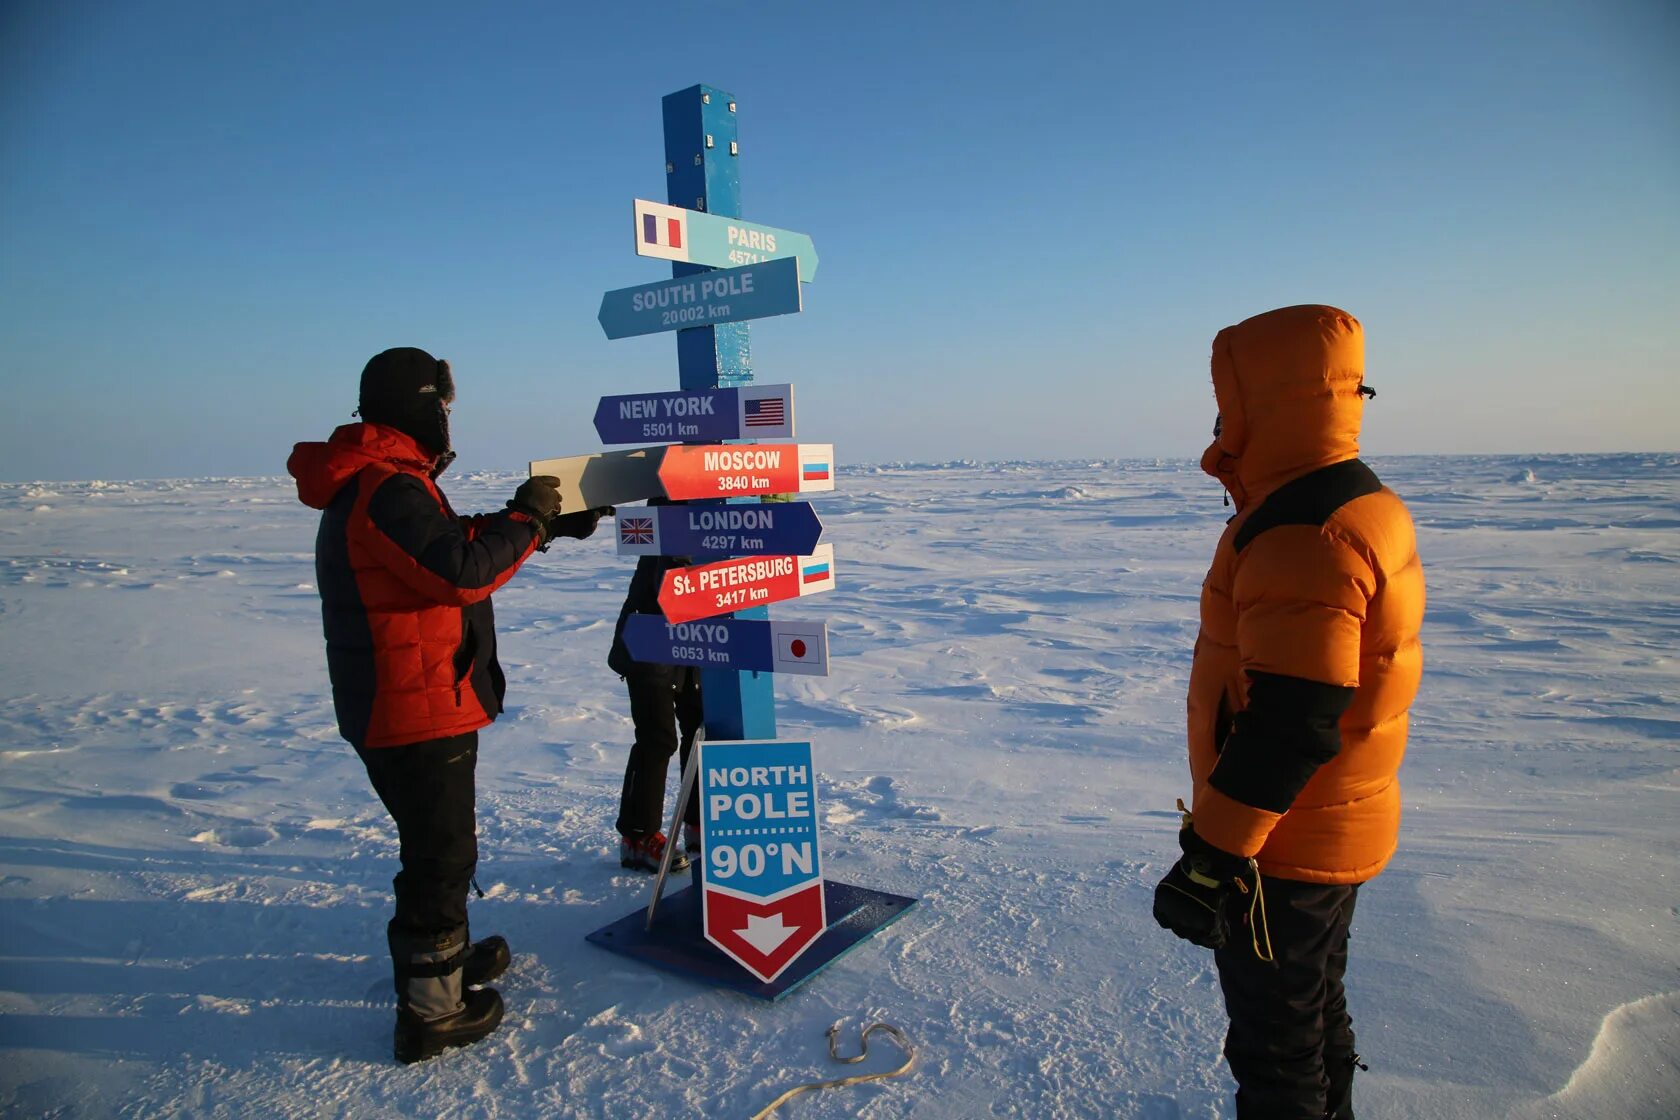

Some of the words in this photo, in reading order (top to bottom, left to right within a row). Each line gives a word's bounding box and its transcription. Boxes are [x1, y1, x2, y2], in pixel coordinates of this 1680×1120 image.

[727, 226, 776, 253] PARIS
[728, 249, 757, 265] 4571
[632, 283, 696, 312] SOUTH
[702, 273, 755, 300] POLE
[708, 304, 730, 319] km
[619, 399, 657, 419] NEW
[662, 396, 715, 417] YORK
[643, 422, 674, 437] 5501
[678, 421, 699, 436] km
[704, 451, 780, 471] MOSCOW
[718, 476, 749, 491] 3840
[751, 475, 770, 489] km
[689, 510, 773, 530] LONDON
[702, 536, 736, 550] 4297
[741, 535, 764, 549] km
[673, 575, 696, 596] St.
[700, 557, 793, 591] PETERSBURG
[715, 590, 746, 608] 3417
[749, 586, 769, 601] km
[665, 622, 729, 644] TOKYO
[671, 646, 705, 660] 6053
[708, 648, 730, 663] km
[709, 765, 807, 788] NORTH
[710, 791, 810, 821] POLE
[711, 842, 813, 878] 90°N
